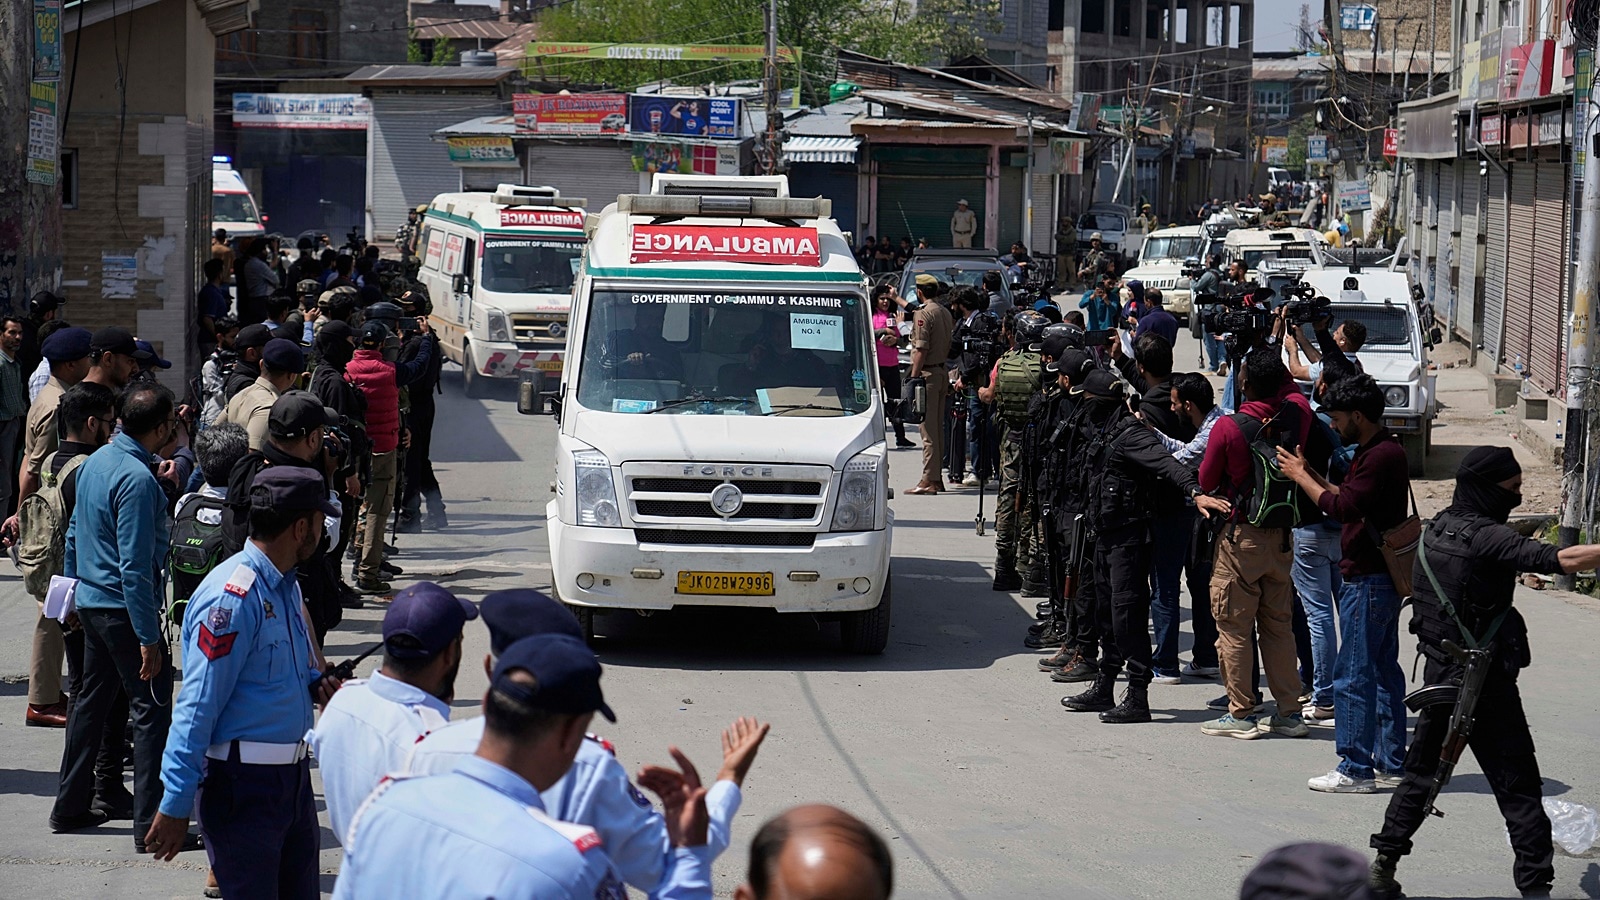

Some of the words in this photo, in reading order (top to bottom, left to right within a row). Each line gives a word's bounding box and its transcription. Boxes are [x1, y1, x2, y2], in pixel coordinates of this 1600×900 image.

[537, 45, 557, 54] CAR
[560, 45, 589, 55] WASH
[607, 46, 644, 59] QUICK
[646, 47, 683, 60] START
[257, 96, 285, 114] QUICK
[289, 99, 316, 112] START
[318, 96, 354, 116] MOTORS
[515, 99, 539, 111] NEW
[542, 99, 556, 112] JK
[558, 99, 621, 112] ROADWAYS
[710, 107, 732, 115] POINT
[486, 241, 531, 249] GOVERNMENT
[542, 241, 565, 249] JAMMU
[631, 294, 712, 305] GOVERNMENT
[714, 294, 730, 304] OF
[732, 295, 775, 306] JAMMU
[778, 296, 787, 306] &
[789, 296, 842, 308] KASHMIR
[792, 317, 838, 327] AMBULANCE
[683, 465, 773, 477] FORCE
[186, 537, 203, 545] TVU
[689, 575, 770, 590] JK02BW2996
